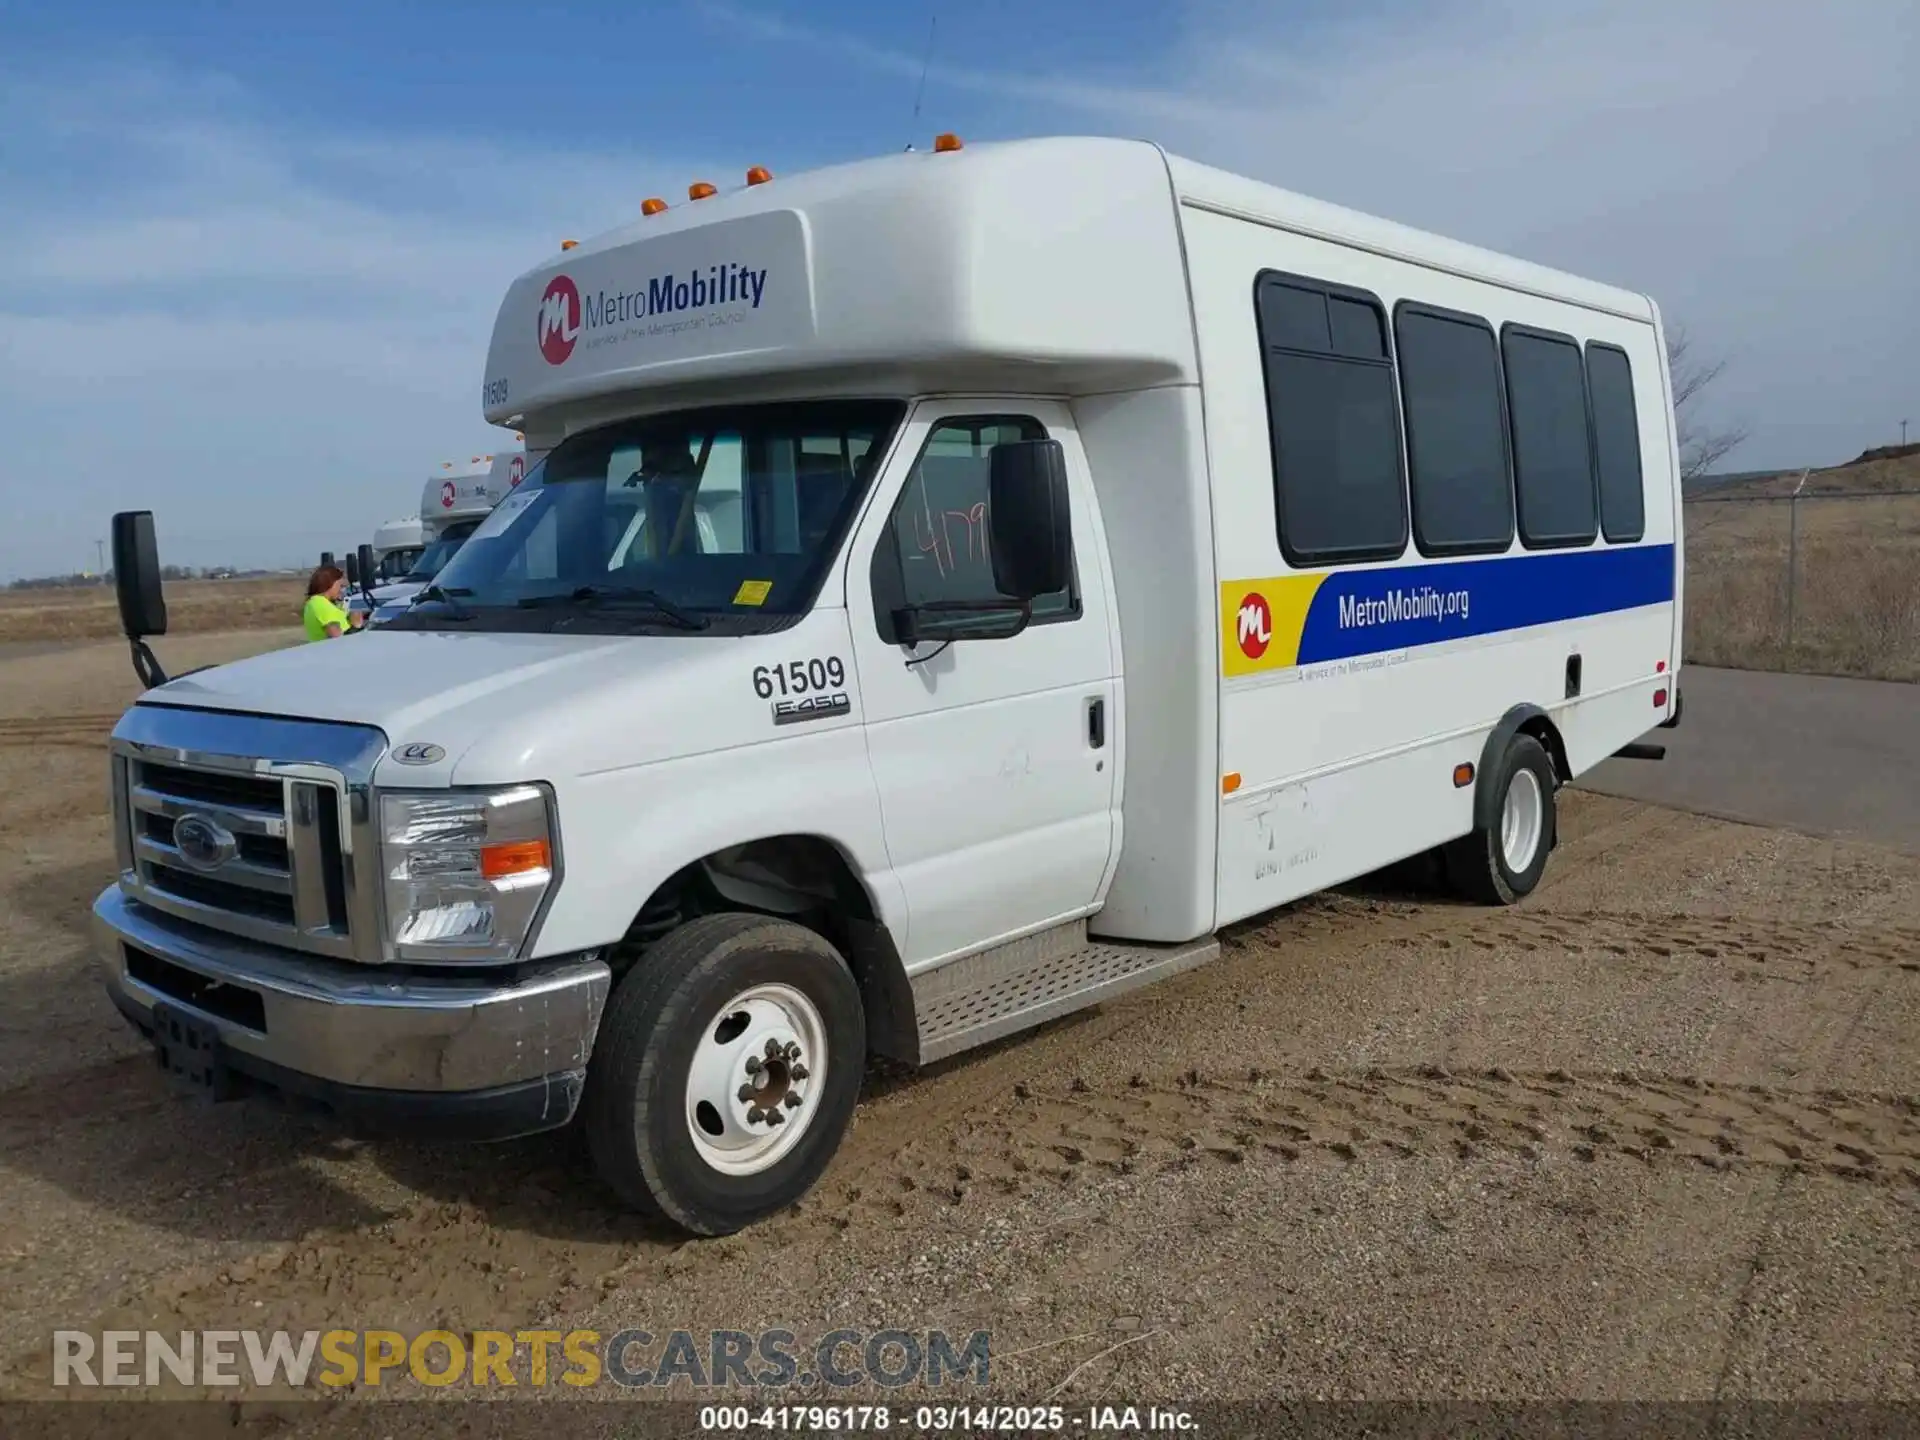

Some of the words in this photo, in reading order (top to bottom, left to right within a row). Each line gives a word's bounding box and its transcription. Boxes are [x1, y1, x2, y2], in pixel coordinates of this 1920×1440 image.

[584, 262, 768, 331] MetroMobility
[1339, 585, 1470, 629] MetroMobility.org
[753, 655, 845, 699] 61509
